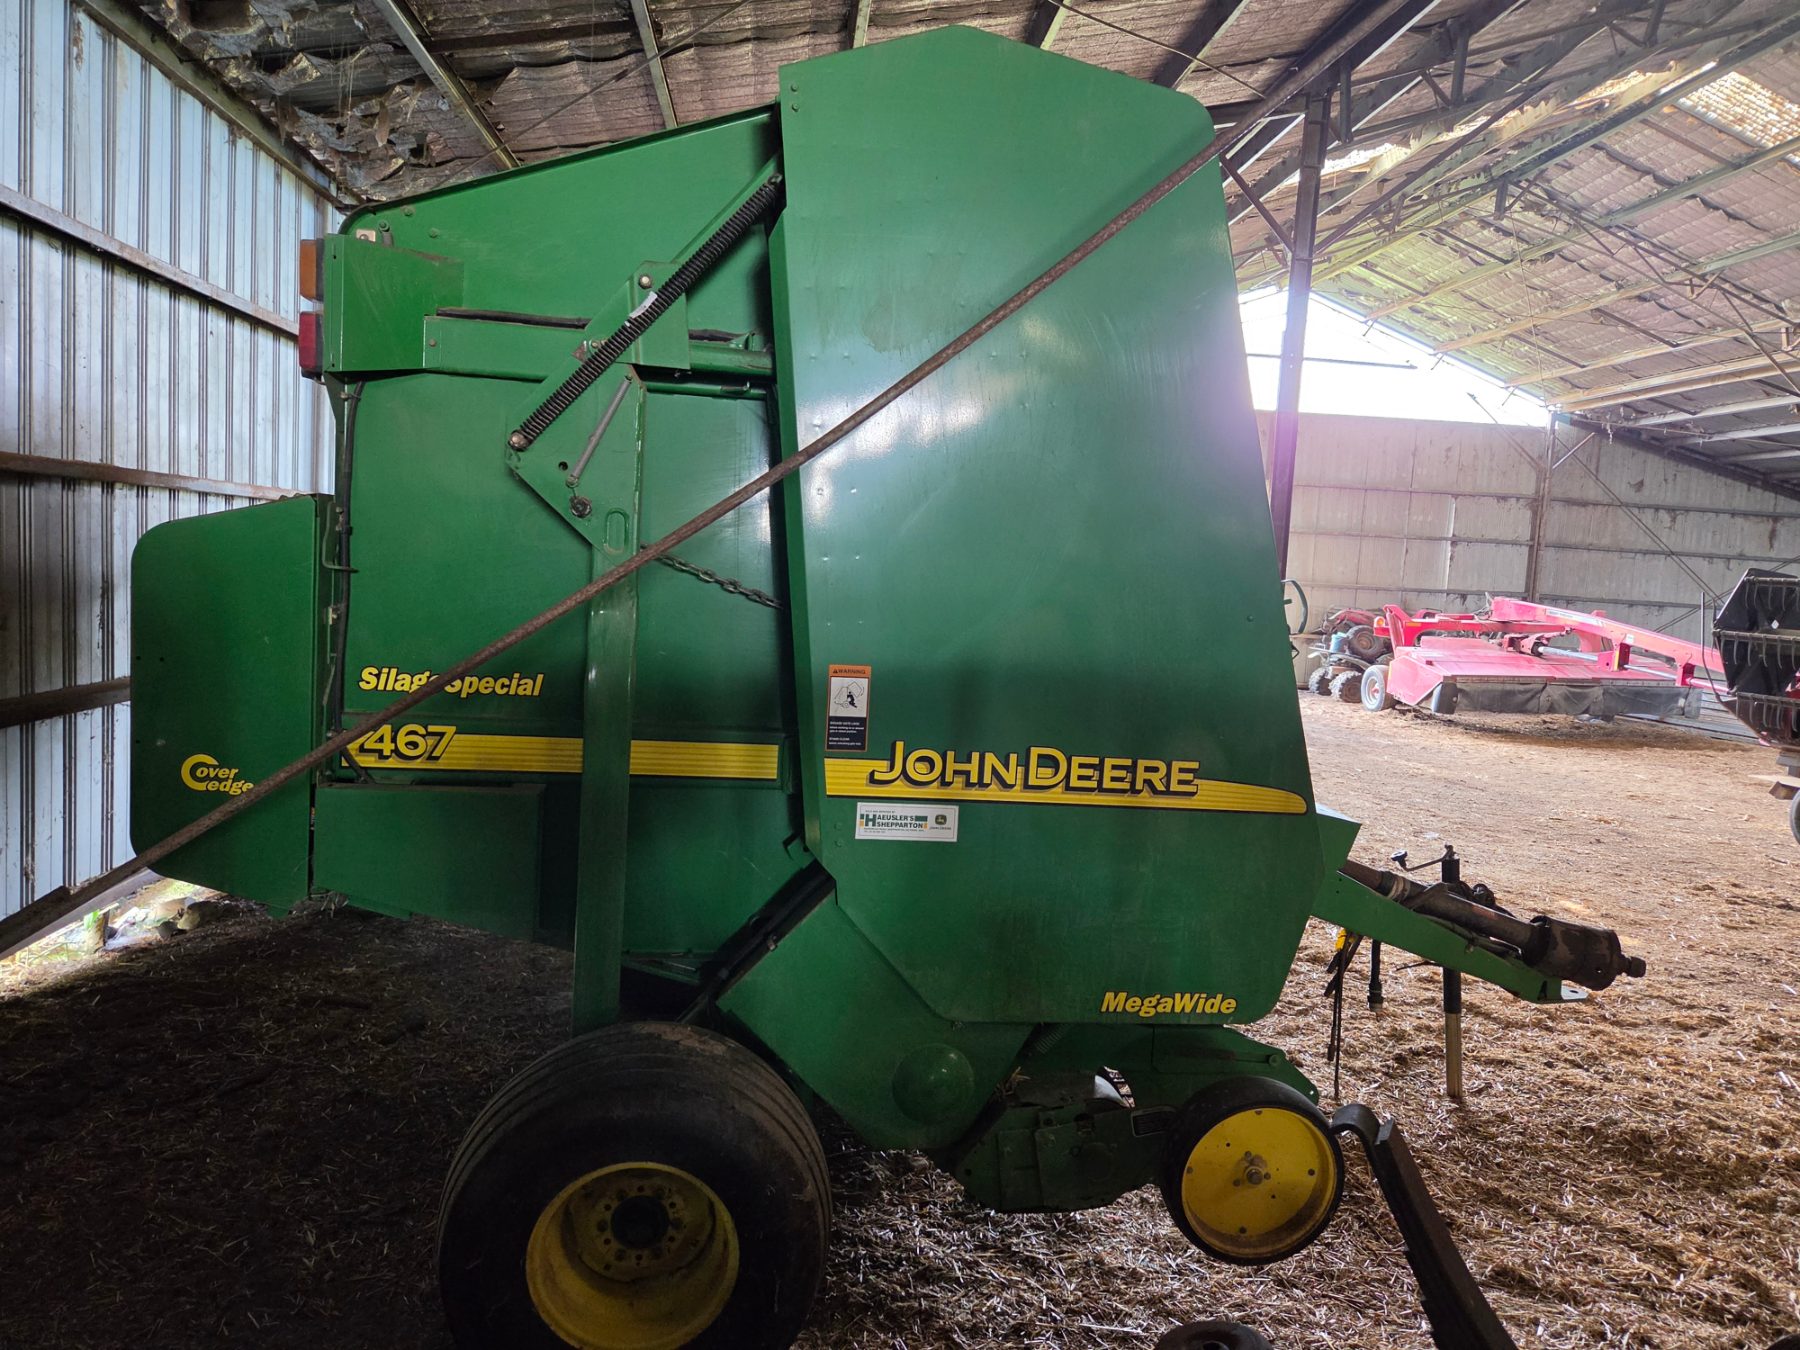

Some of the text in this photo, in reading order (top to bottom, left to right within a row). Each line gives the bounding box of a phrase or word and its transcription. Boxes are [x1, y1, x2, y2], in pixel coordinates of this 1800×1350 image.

[358, 666, 439, 693] Silag
[362, 723, 457, 759] 467
[181, 753, 239, 791] Cover
[871, 740, 1200, 793] JOHN DEERE
[207, 778, 254, 795] edge
[876, 821, 924, 829] SHEPPARTON
[1100, 991, 1237, 1017] MegaWide
